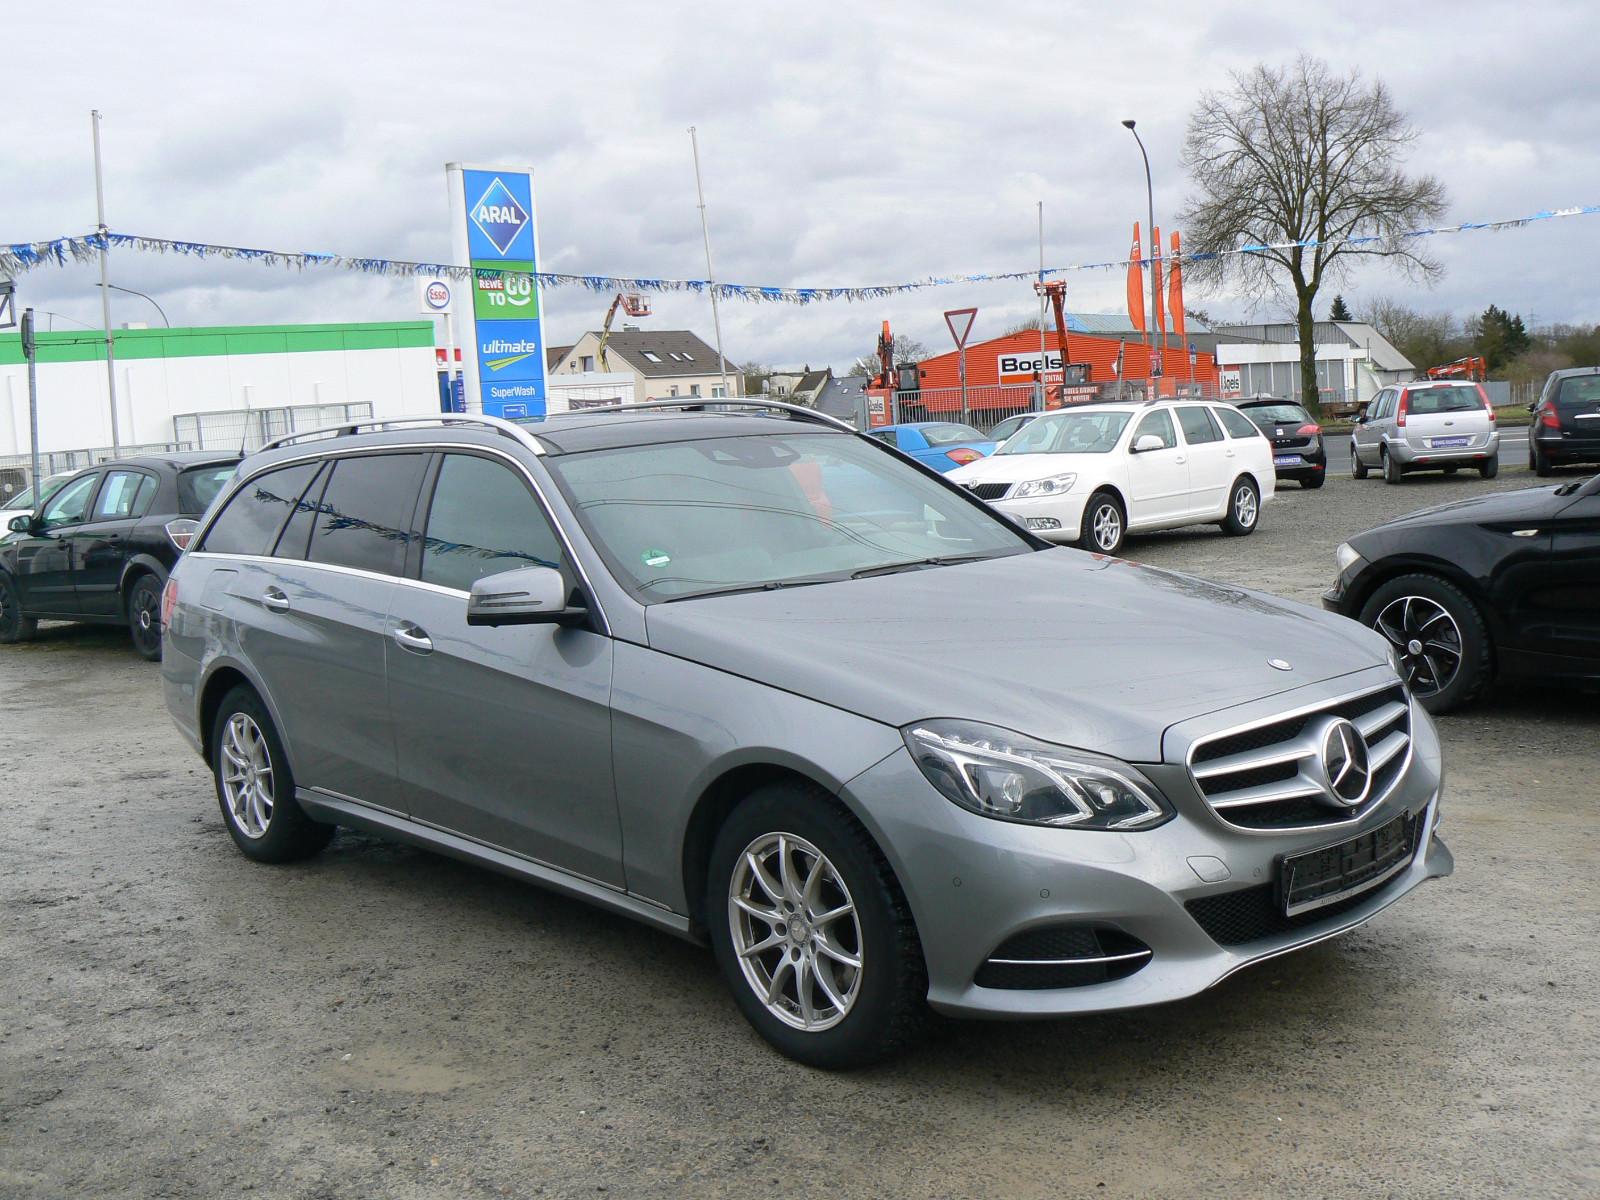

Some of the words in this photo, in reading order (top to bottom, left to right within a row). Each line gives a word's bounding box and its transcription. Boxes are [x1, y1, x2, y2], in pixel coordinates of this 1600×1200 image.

[479, 205, 521, 224] ARAL
[479, 279, 503, 289] REWE
[488, 292, 506, 306] TO
[505, 276, 531, 296] GO
[483, 339, 536, 354] ultimate
[1001, 355, 1063, 372] Boels
[1045, 374, 1063, 383] ENTAL
[491, 386, 536, 399] SuperWash
